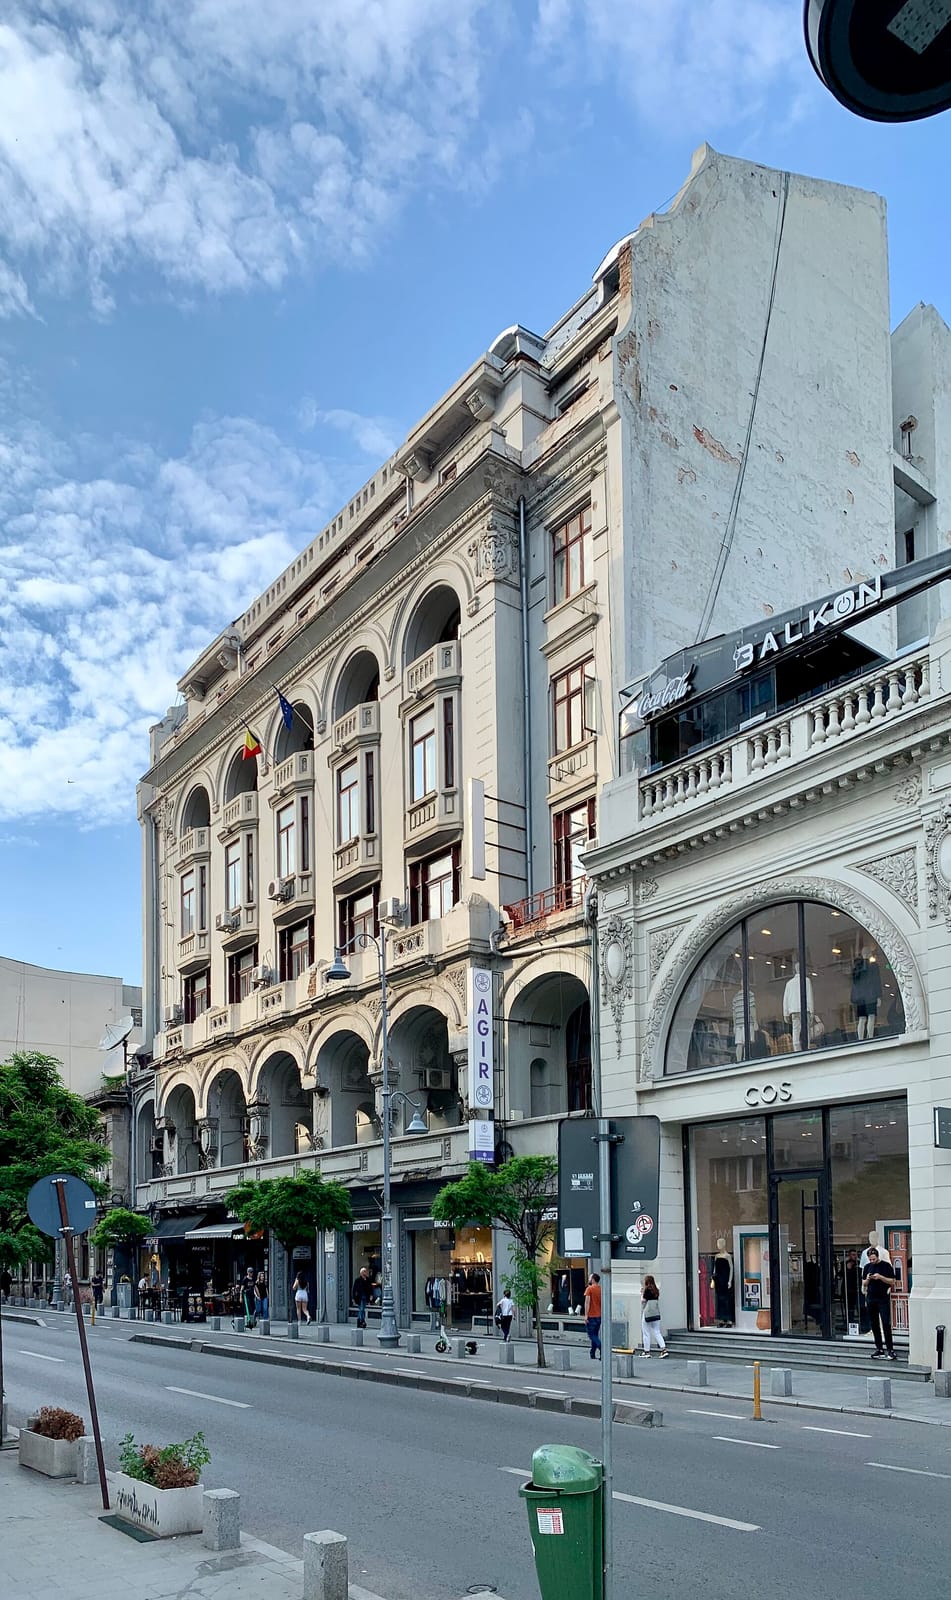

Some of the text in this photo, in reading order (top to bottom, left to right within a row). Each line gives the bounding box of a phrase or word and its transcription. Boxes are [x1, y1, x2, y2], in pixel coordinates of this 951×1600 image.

[733, 575, 882, 671] BALKON
[477, 998, 490, 1080] AGIR
[744, 1081, 793, 1107] COS
